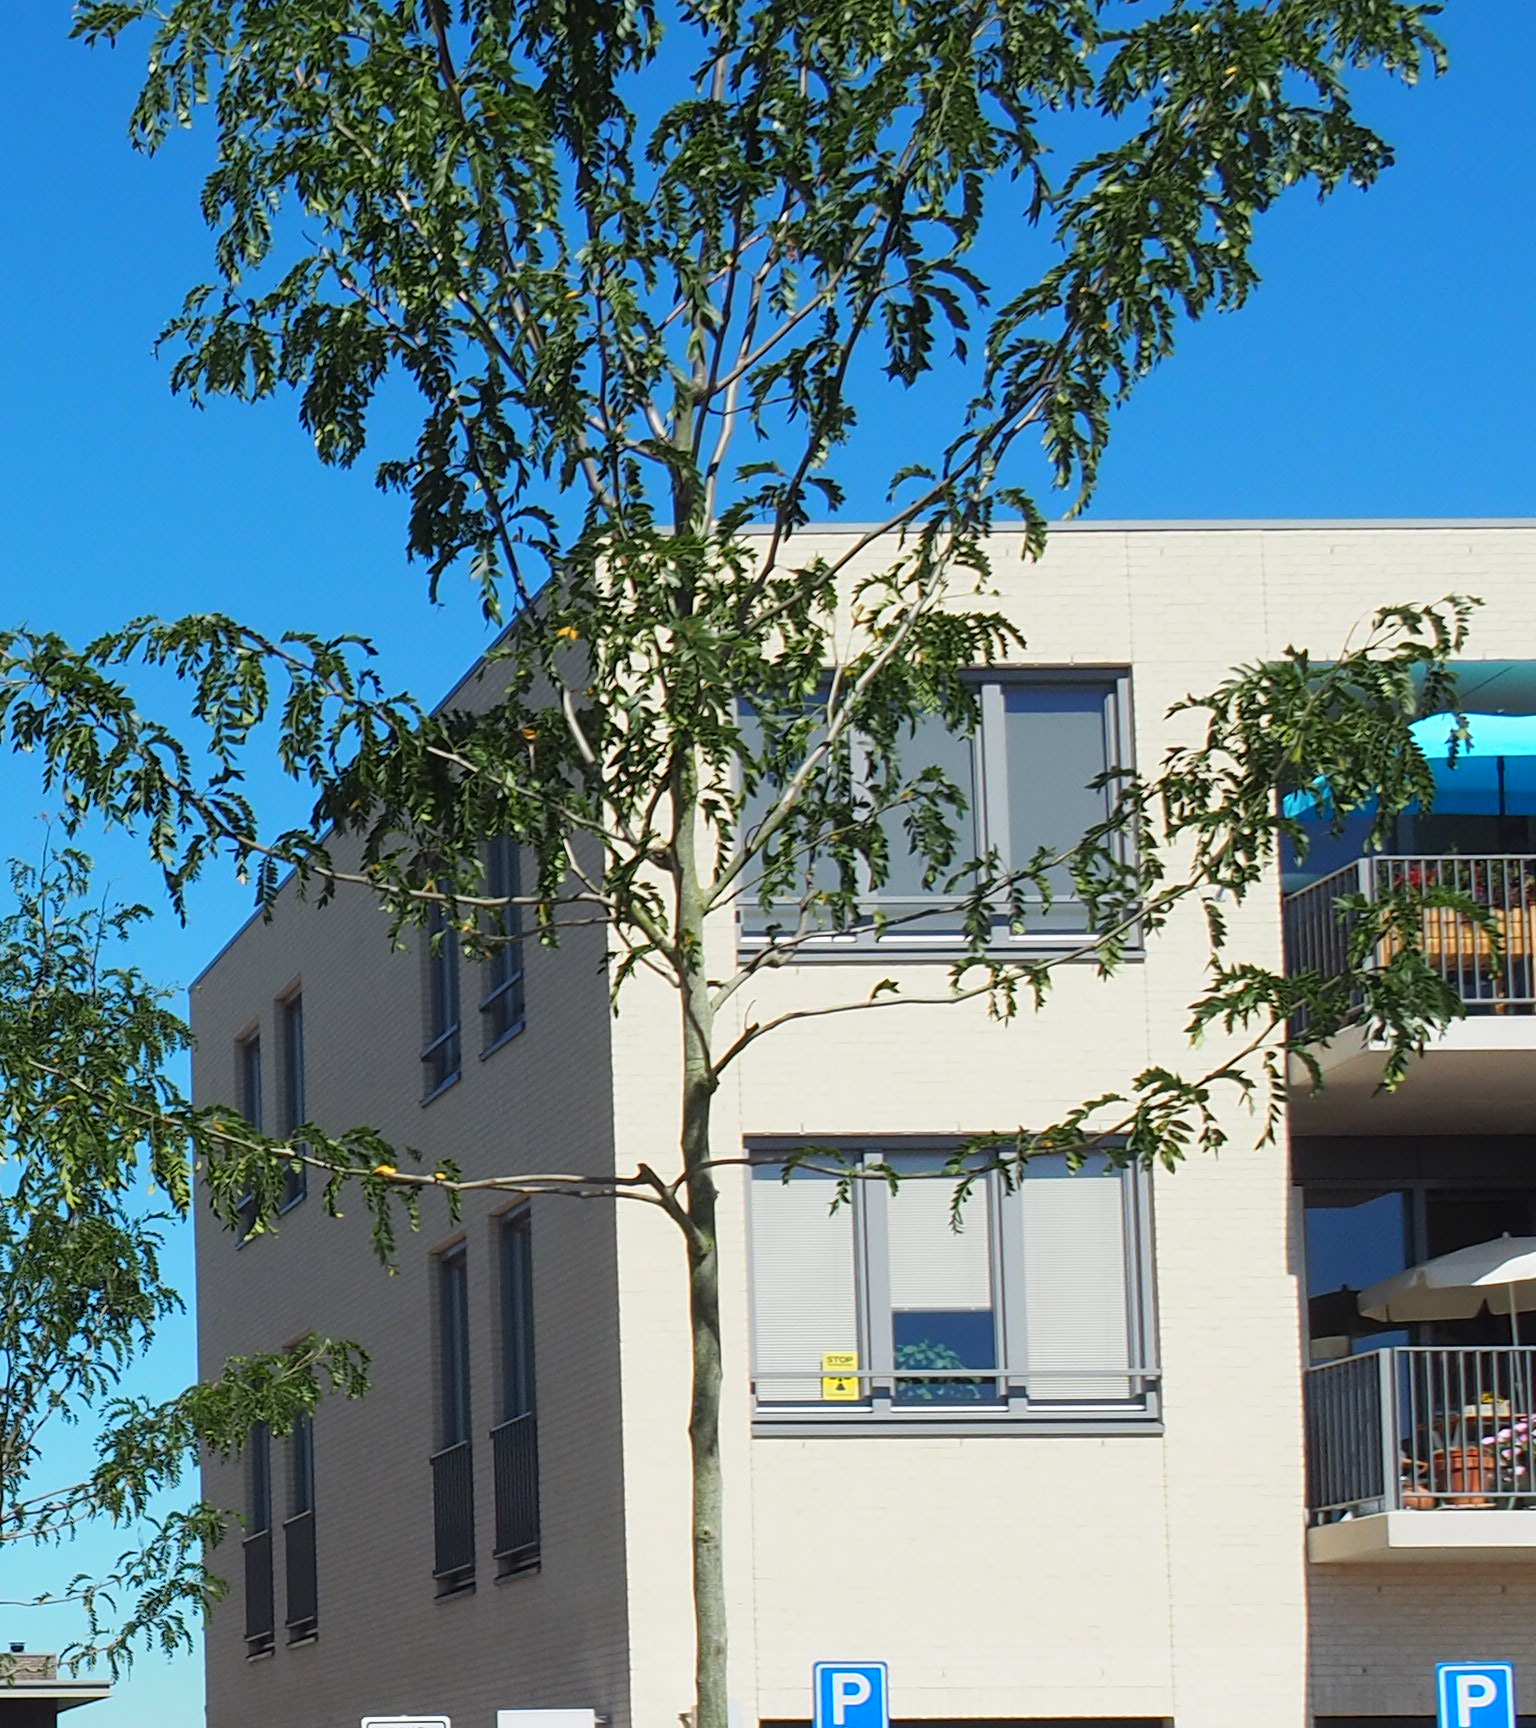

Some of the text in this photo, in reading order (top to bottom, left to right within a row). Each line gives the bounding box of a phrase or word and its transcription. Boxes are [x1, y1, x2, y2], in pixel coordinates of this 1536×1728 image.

[826, 1356, 854, 1364] STOP
[832, 1672, 872, 1725] P
[1458, 1673, 1497, 1727] P
